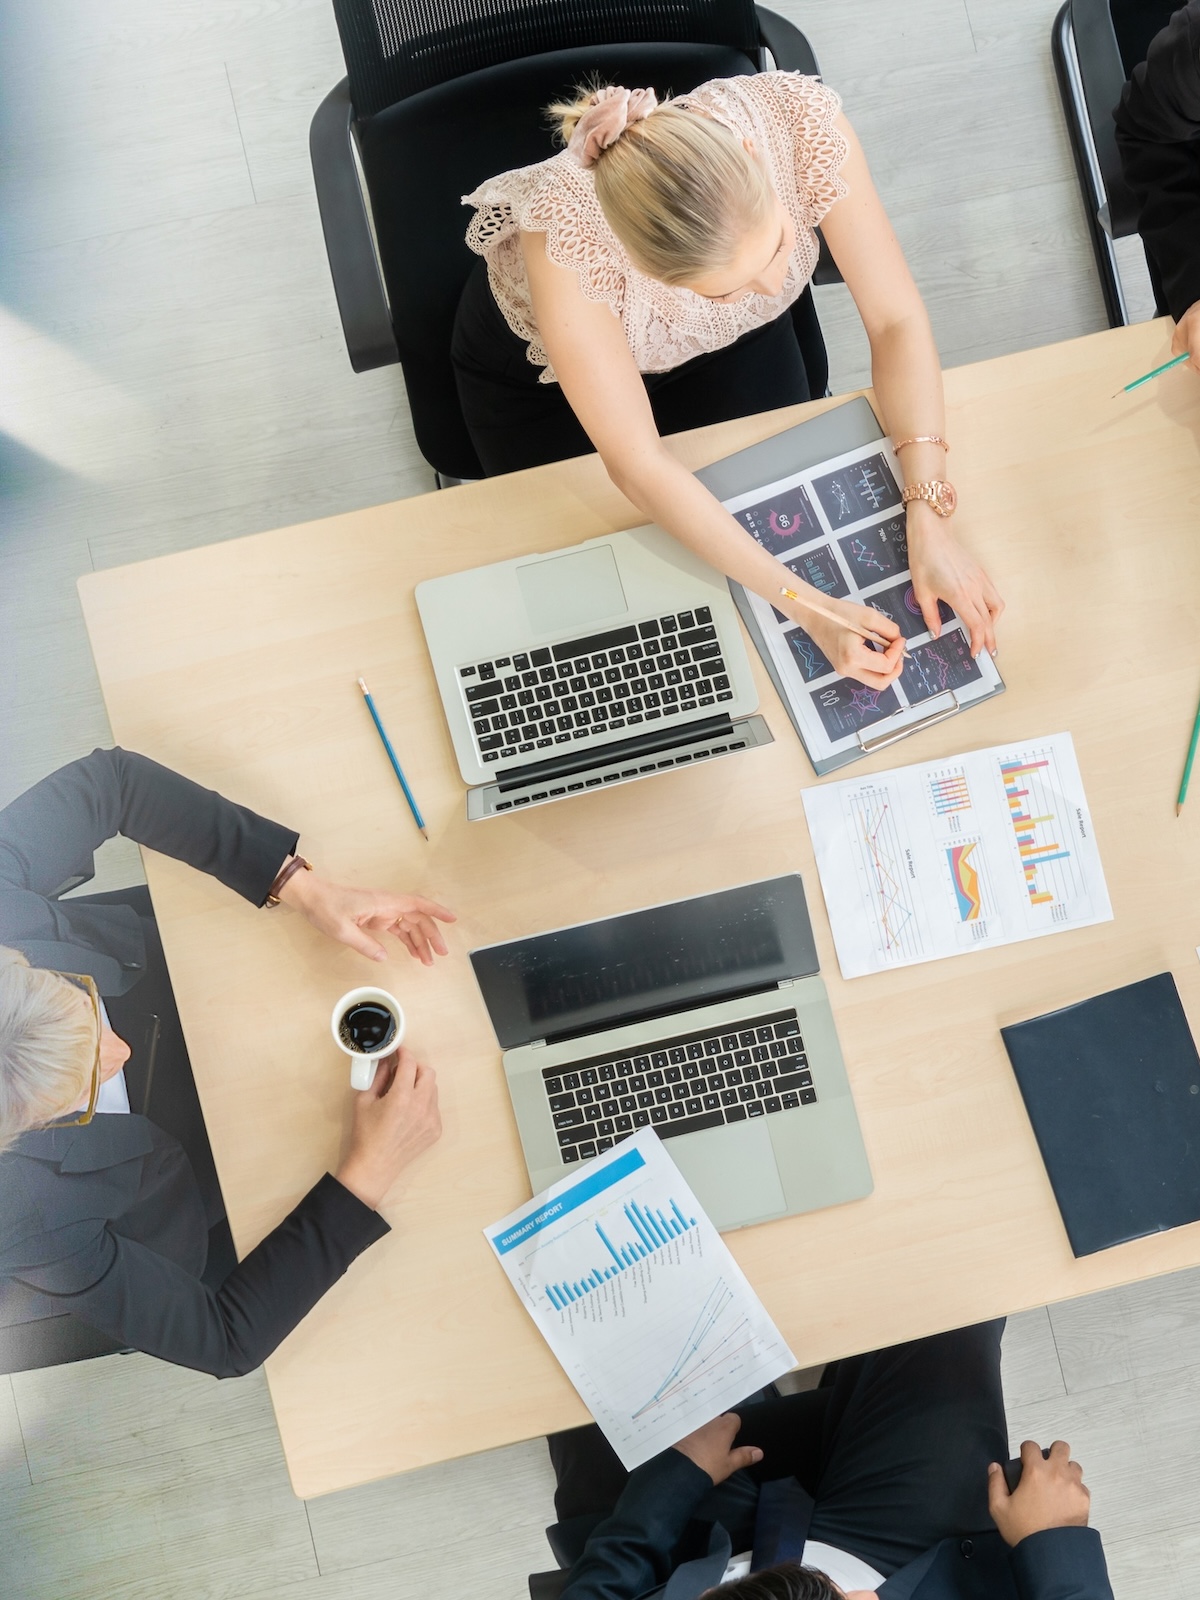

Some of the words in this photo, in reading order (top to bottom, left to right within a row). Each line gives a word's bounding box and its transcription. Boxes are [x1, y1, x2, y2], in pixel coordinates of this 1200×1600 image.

[778, 514, 791, 528] 66
[501, 1221, 535, 1246] SUMMARY
[534, 1202, 563, 1225] REPORT
